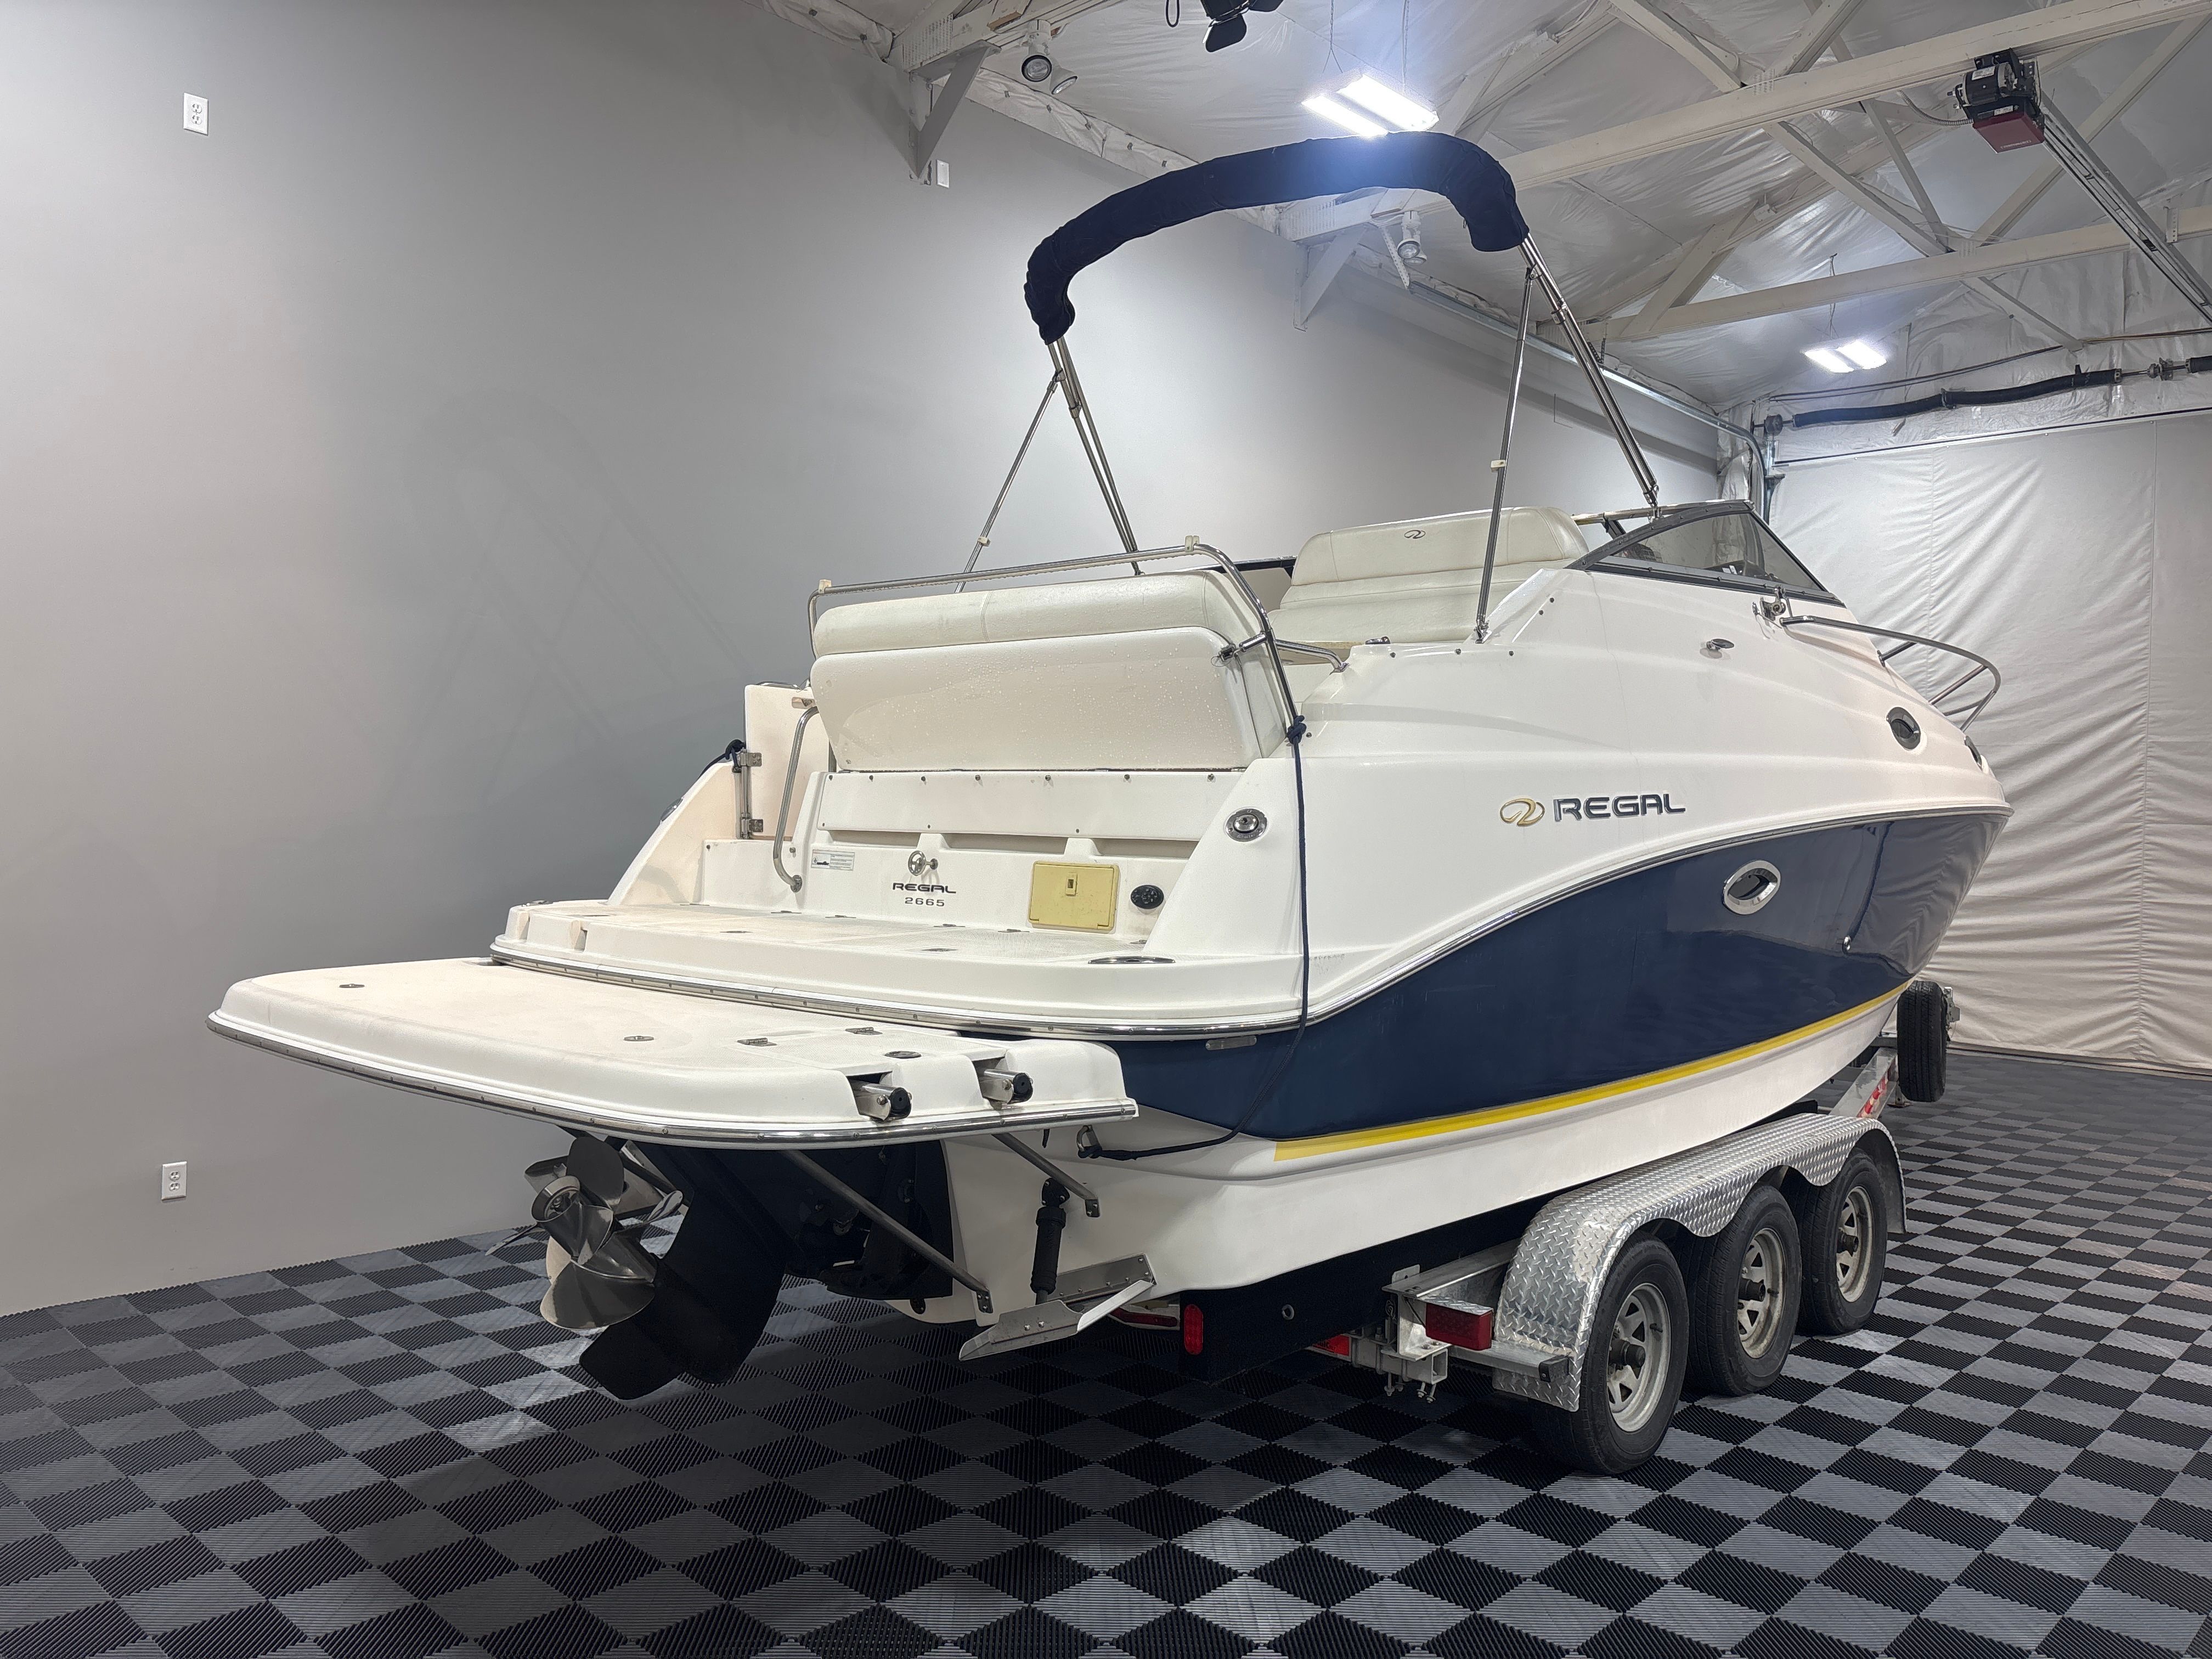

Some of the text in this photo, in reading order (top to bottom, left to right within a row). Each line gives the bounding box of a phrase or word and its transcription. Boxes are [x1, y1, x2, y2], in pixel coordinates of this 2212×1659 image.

[1553, 793, 1686, 822] REGAL
[892, 882, 957, 894] REGAL
[905, 897, 945, 907] 2665
